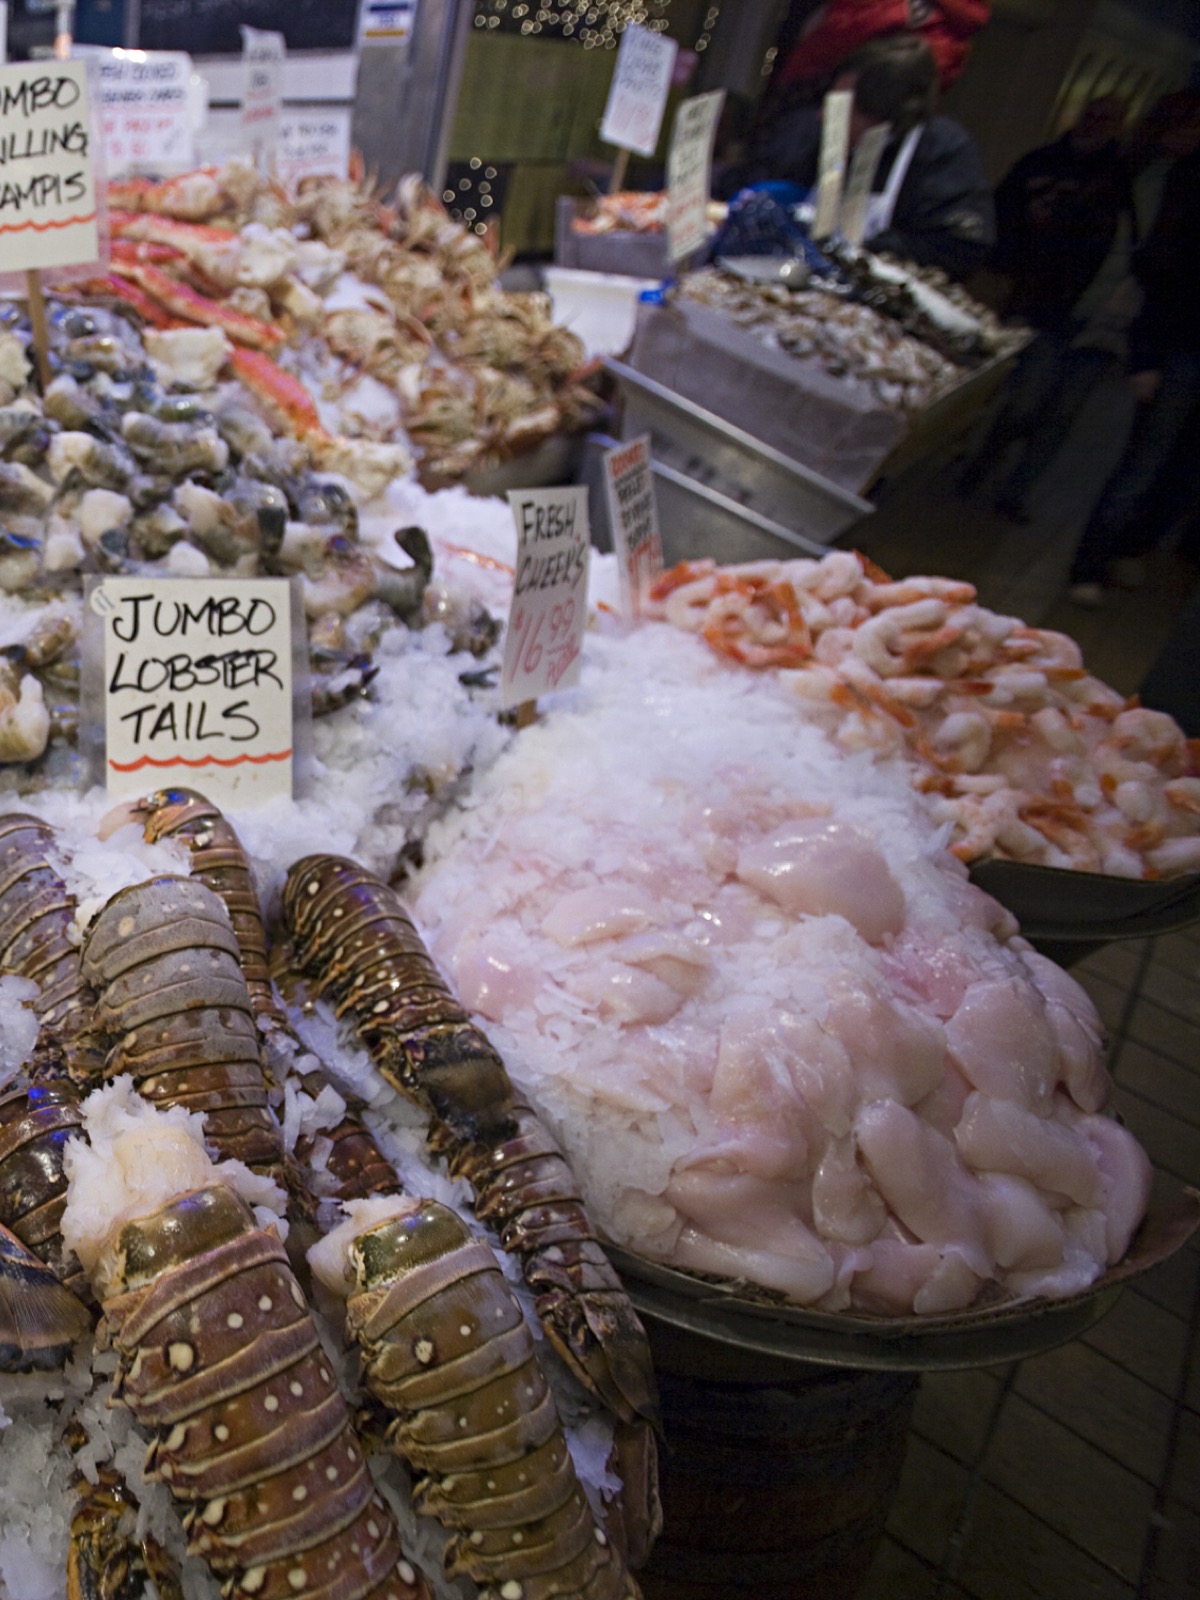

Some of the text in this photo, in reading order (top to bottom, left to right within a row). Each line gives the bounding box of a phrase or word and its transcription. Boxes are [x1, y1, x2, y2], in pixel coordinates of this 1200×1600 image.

[522, 500, 577, 546] FRESH
[516, 542, 586, 597] CHEEKS
[112, 594, 276, 642] JUMBO
[109, 649, 284, 694] LOBSTER
[120, 700, 260, 744] TAILS
